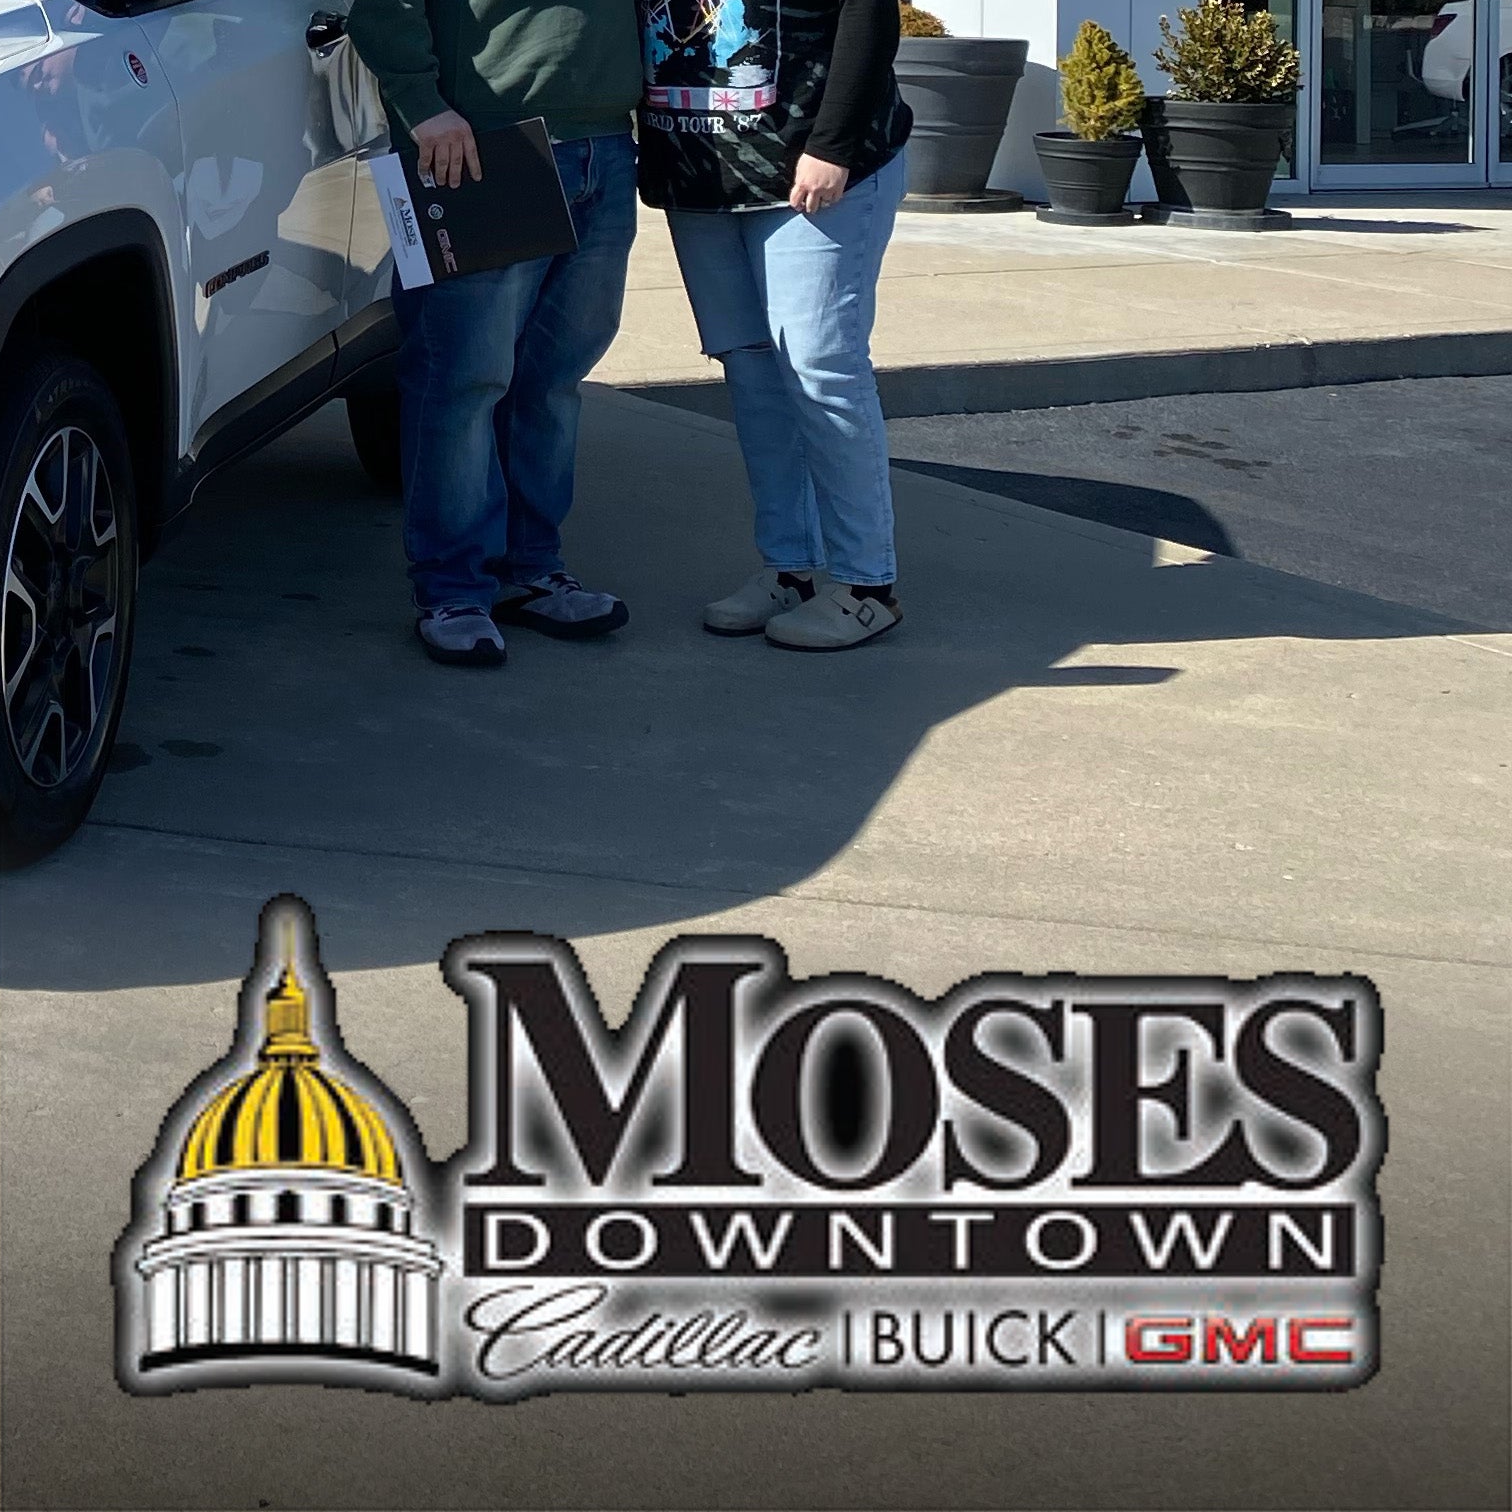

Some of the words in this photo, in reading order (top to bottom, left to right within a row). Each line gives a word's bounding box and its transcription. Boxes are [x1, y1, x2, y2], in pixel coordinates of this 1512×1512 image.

[678, 116, 727, 134] TOUR
[733, 113, 762, 133] '87
[436, 228, 458, 273] GMC
